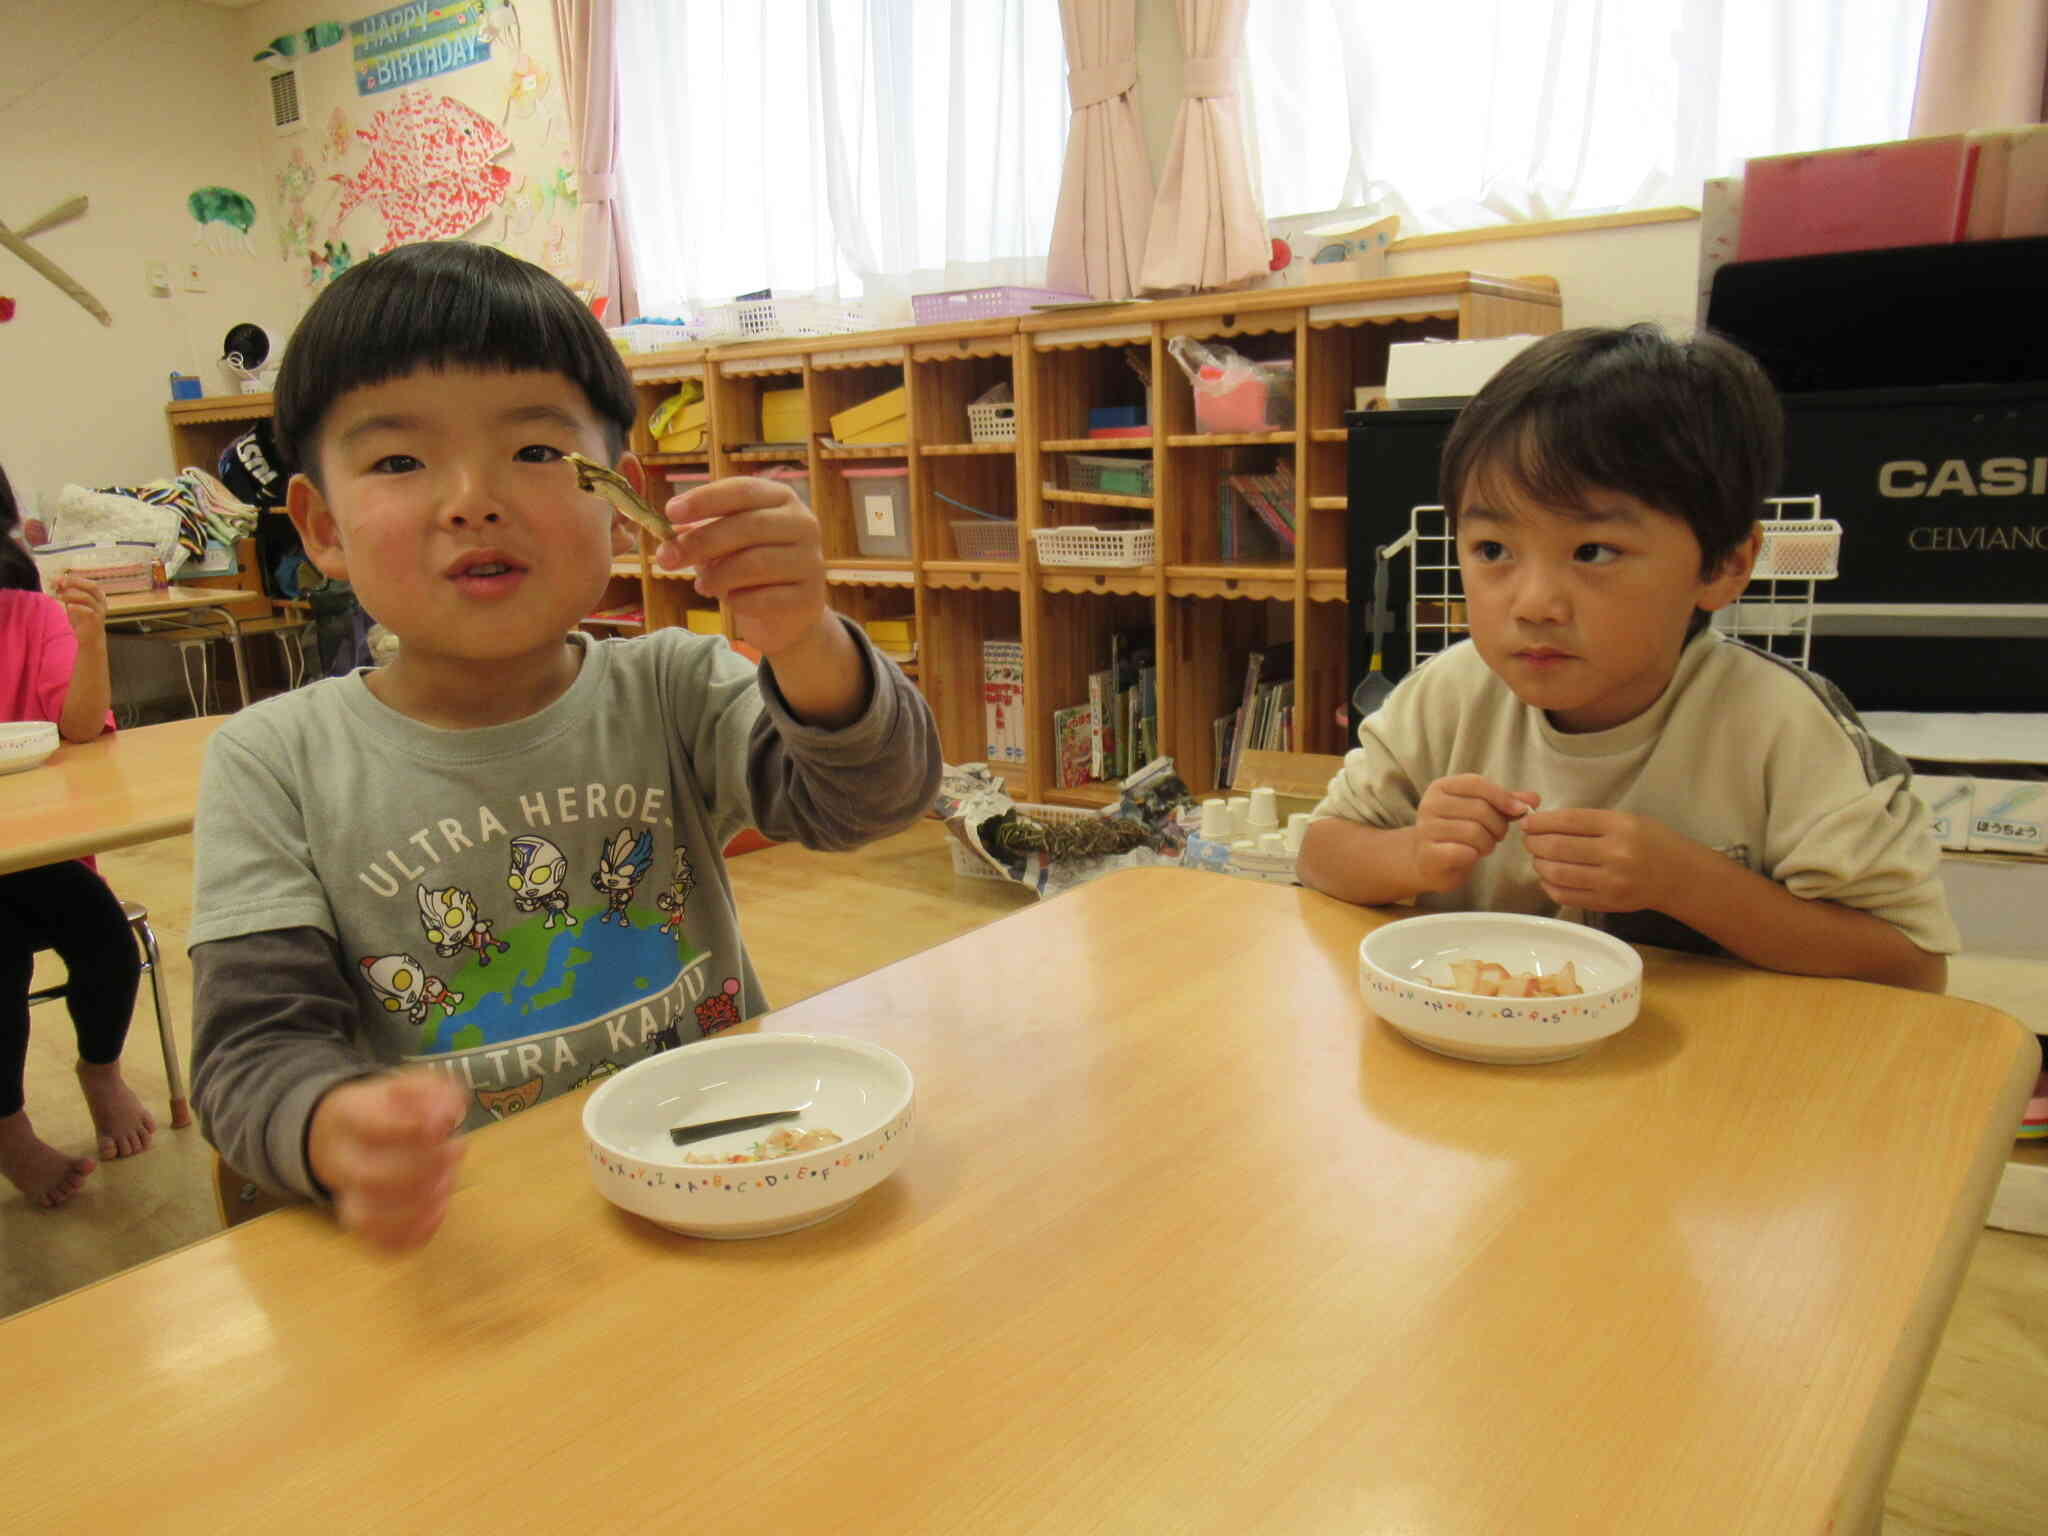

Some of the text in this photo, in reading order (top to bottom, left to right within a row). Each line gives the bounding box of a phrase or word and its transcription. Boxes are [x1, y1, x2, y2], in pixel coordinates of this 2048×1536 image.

[362, 0, 429, 50] HAPPY
[376, 25, 480, 85] BIRTHDAY
[1879, 457, 2048, 498] CASI
[358, 782, 673, 898] ULTRA HEROE
[1976, 819, 2039, 838] ほうちょう
[605, 965, 706, 1055] KAIJU
